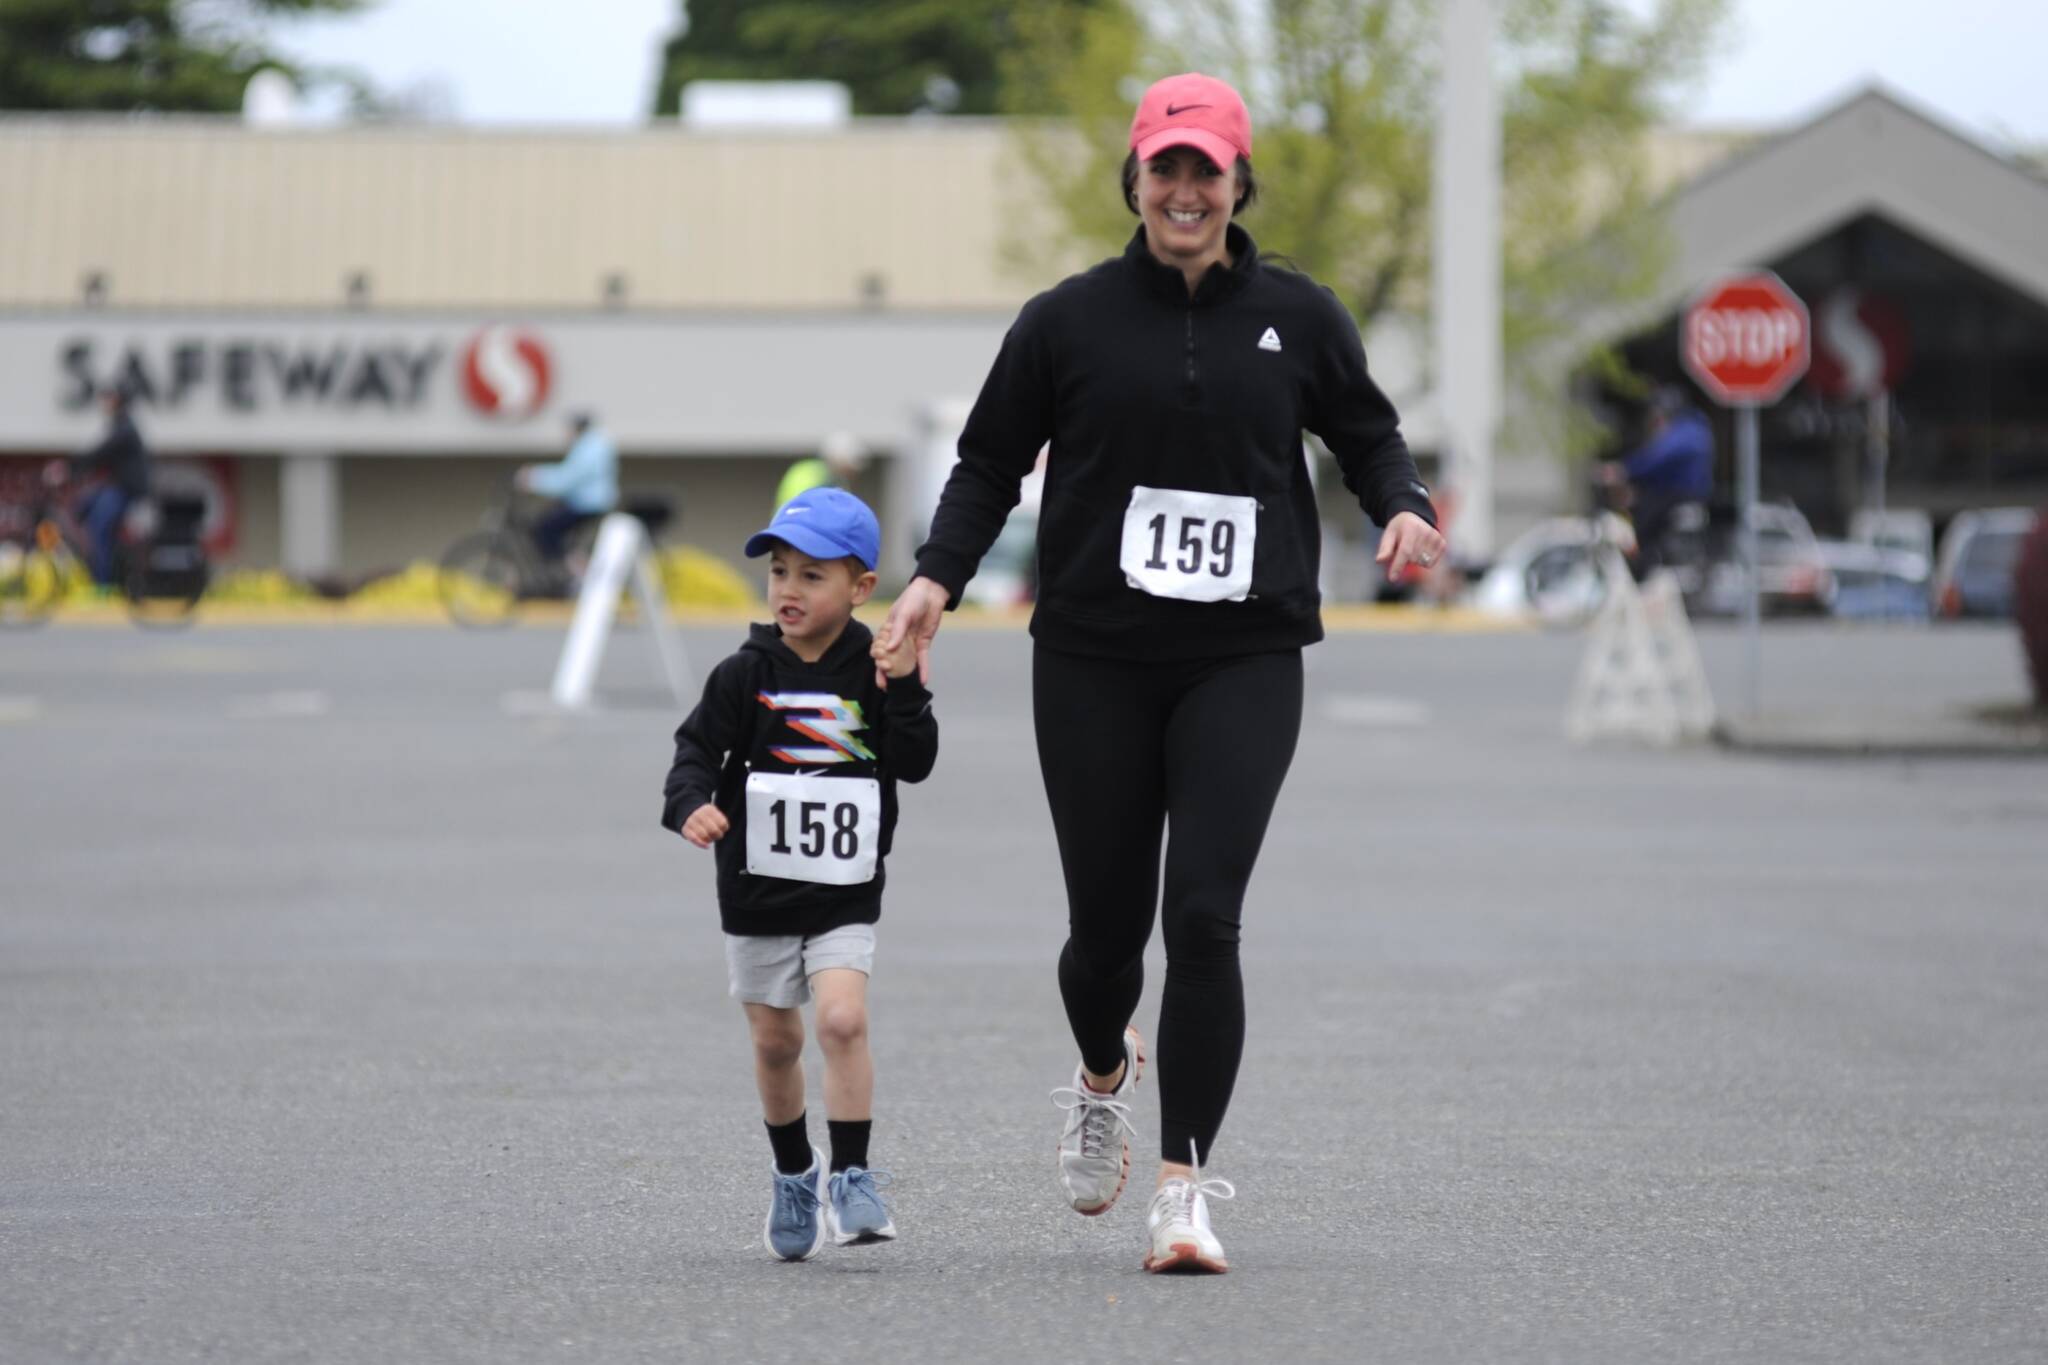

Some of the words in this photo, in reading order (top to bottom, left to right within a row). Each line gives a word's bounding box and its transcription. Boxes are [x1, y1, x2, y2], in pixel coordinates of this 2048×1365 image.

[1699, 307, 1800, 365] STOP
[60, 337, 446, 412] SAFEWAY
[1144, 513, 1236, 578] 159
[769, 799, 860, 860] 158
